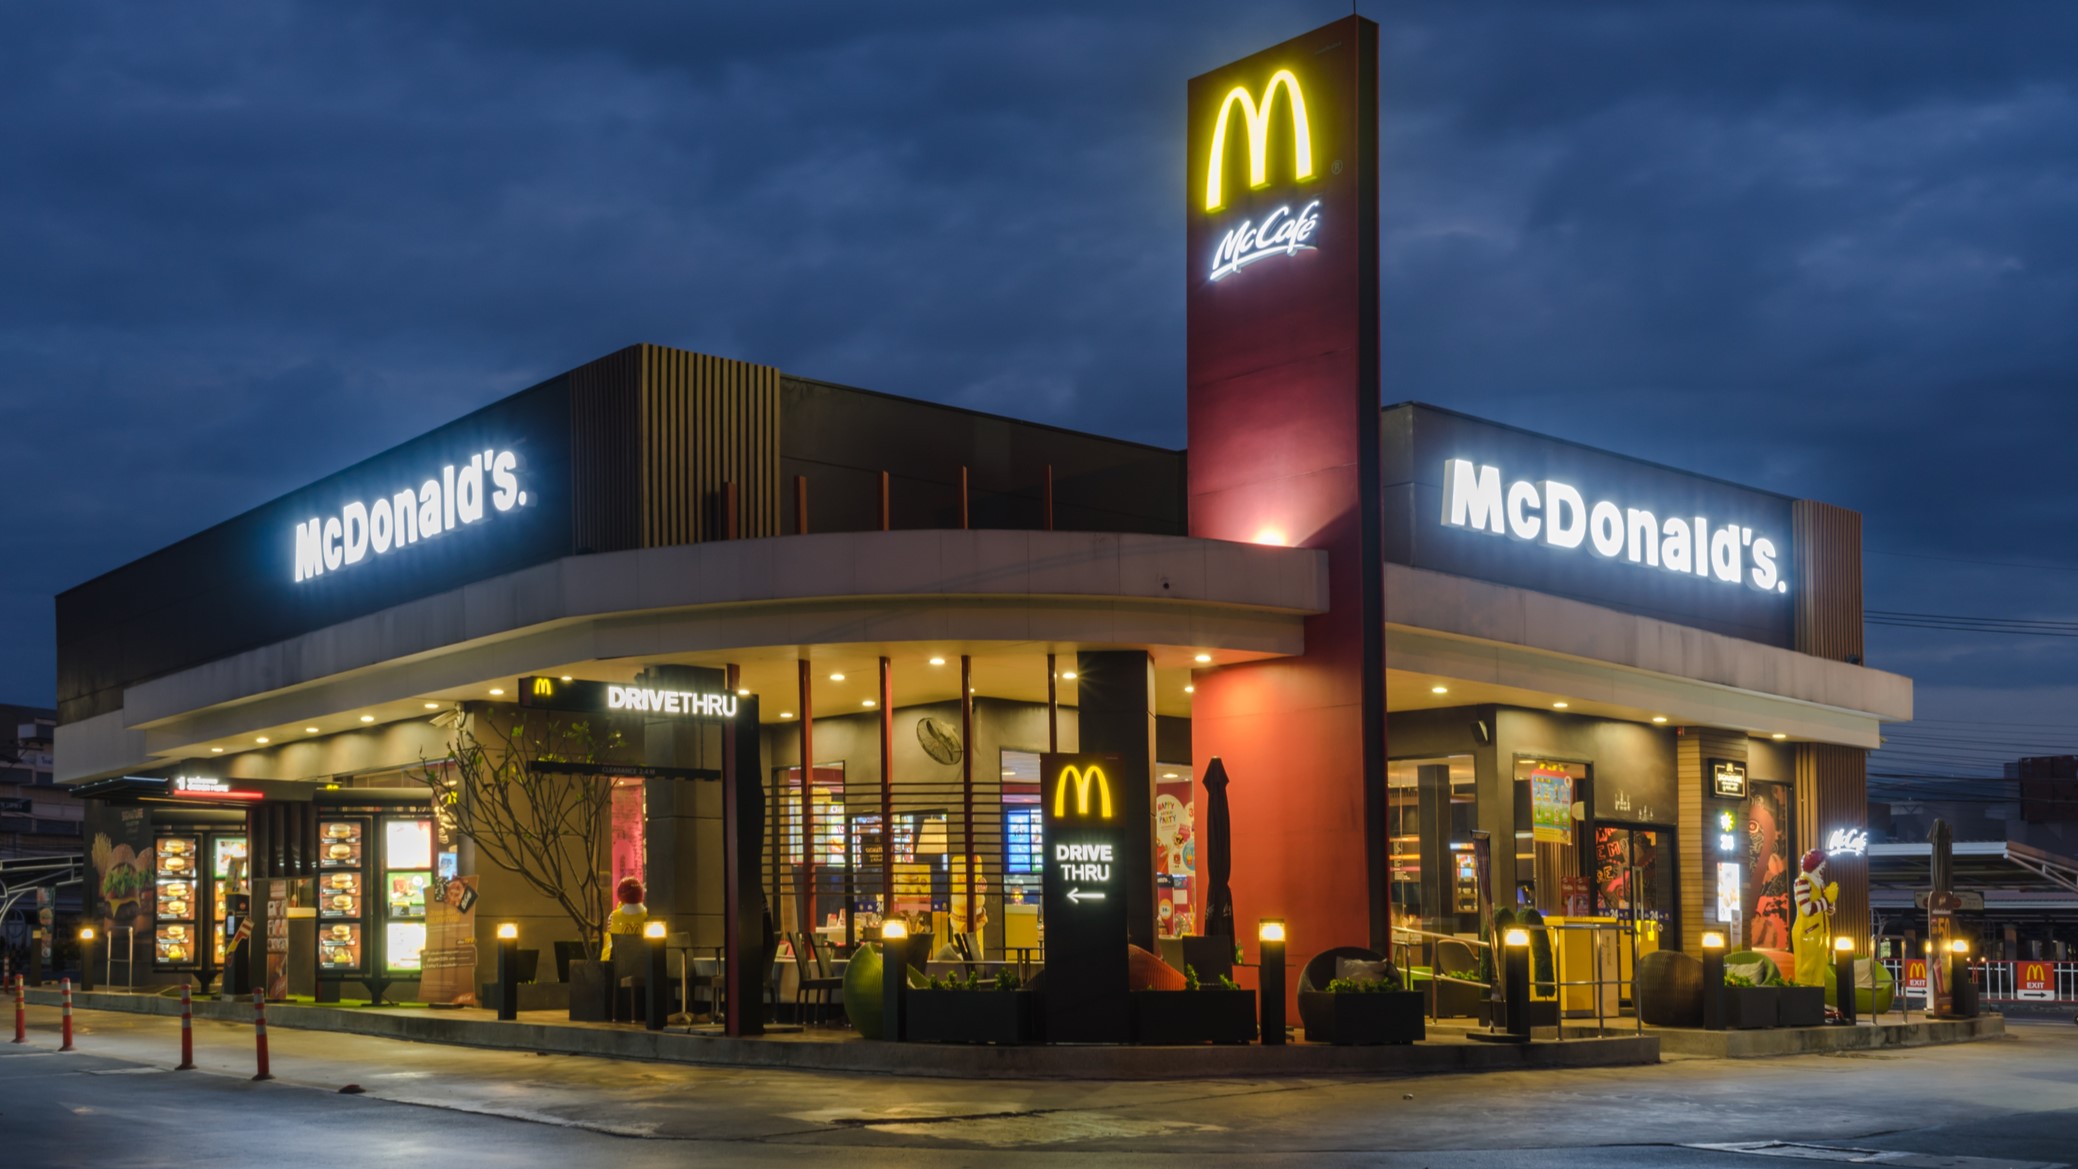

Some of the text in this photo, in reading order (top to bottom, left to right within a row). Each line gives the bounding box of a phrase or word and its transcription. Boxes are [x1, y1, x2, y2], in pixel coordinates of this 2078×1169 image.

[1209, 200, 1319, 280] McCafé
[1056, 844, 1112, 862] DRIVE
[1061, 864, 1110, 881] THRU
